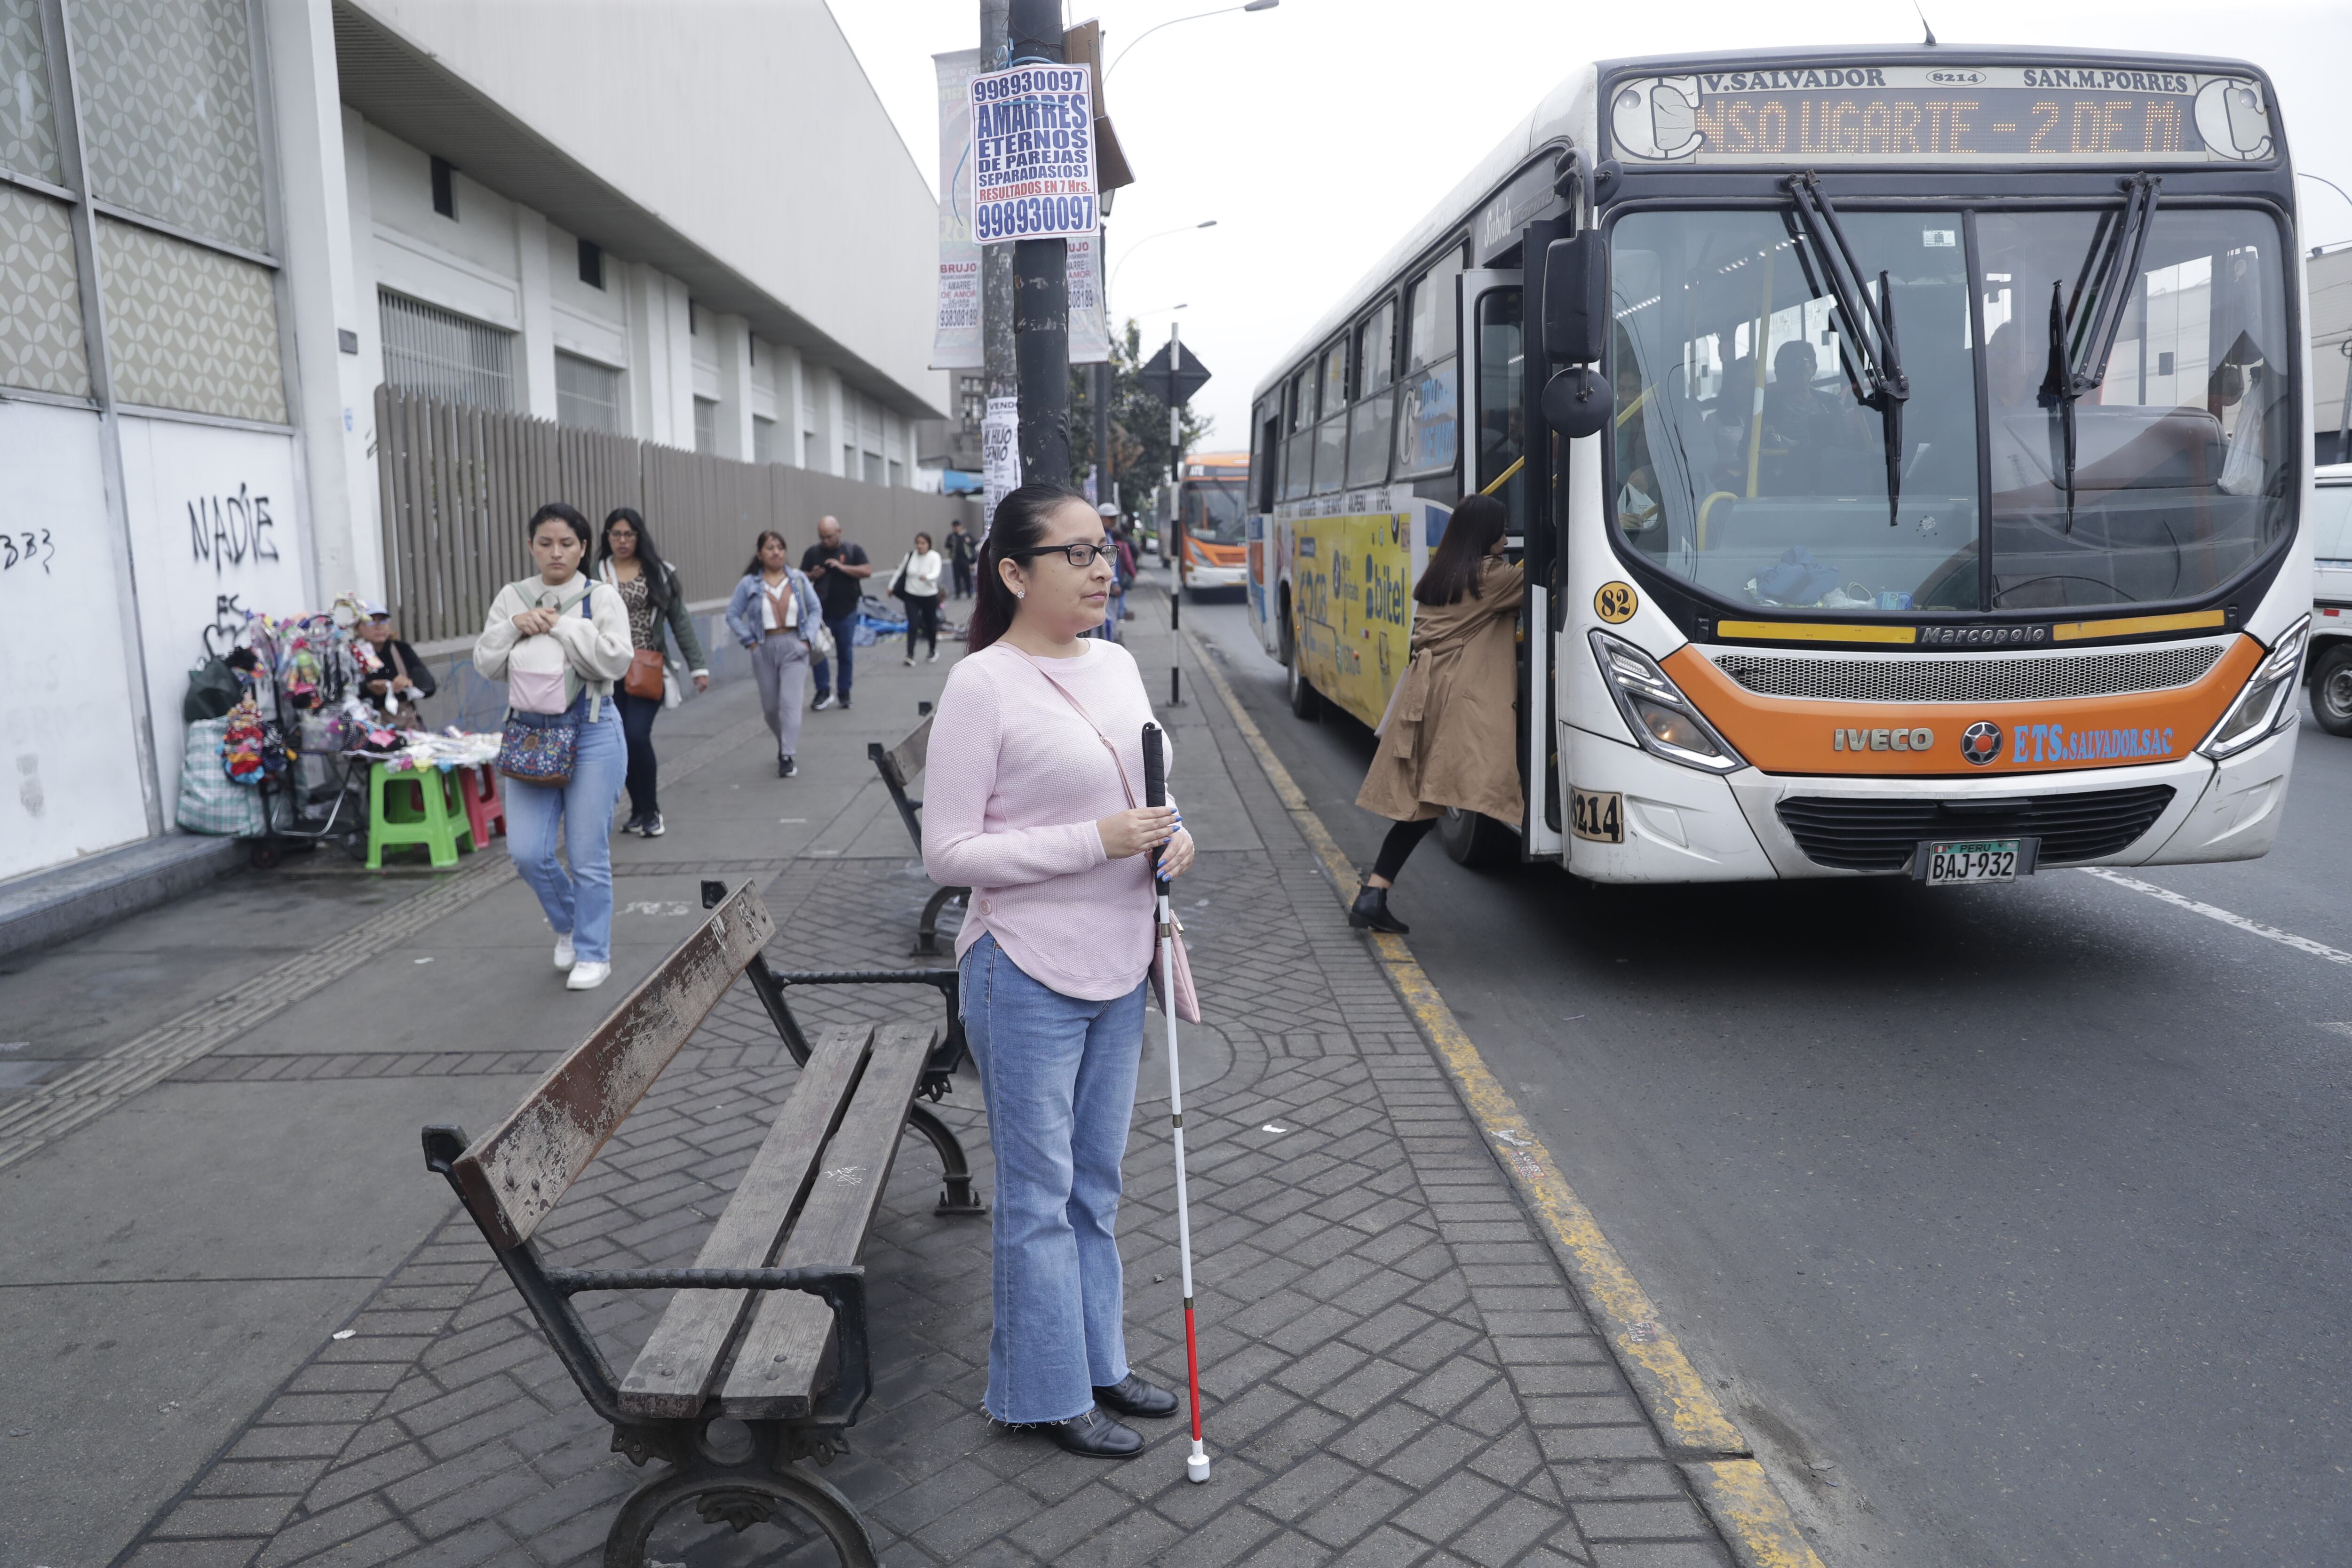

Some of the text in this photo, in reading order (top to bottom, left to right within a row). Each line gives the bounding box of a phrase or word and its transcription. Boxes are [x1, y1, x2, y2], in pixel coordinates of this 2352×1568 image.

[974, 71, 1082, 102] 998930097
[1703, 68, 1887, 92] V.SALVADOR
[1932, 72, 1979, 83] 8214
[2023, 69, 2188, 93] SAN.M.PORRES
[977, 94, 1087, 139] AMARRES
[1801, 101, 1979, 153] UGARTE
[2030, 101, 2059, 153] 2
[2071, 101, 2132, 153] DE
[2144, 101, 2182, 152] M
[978, 129, 1088, 159] ETERNOS
[978, 150, 1088, 173] DE PAREJAS
[980, 180, 1090, 201] RESULTADOS EN 7 Hrs.
[978, 196, 1093, 238] 998930097
[1485, 196, 1511, 248] Subida
[1068, 242, 1089, 252] UJO
[940, 263, 977, 273] BRUJO
[1375, 564, 1405, 627] bitel
[1601, 589, 1630, 617] 82
[1922, 627, 2045, 644] Marcopolo
[1834, 727, 1934, 751] IVECO
[1960, 844, 1991, 853] PERU
[1932, 852, 2014, 879] BAJ-932
